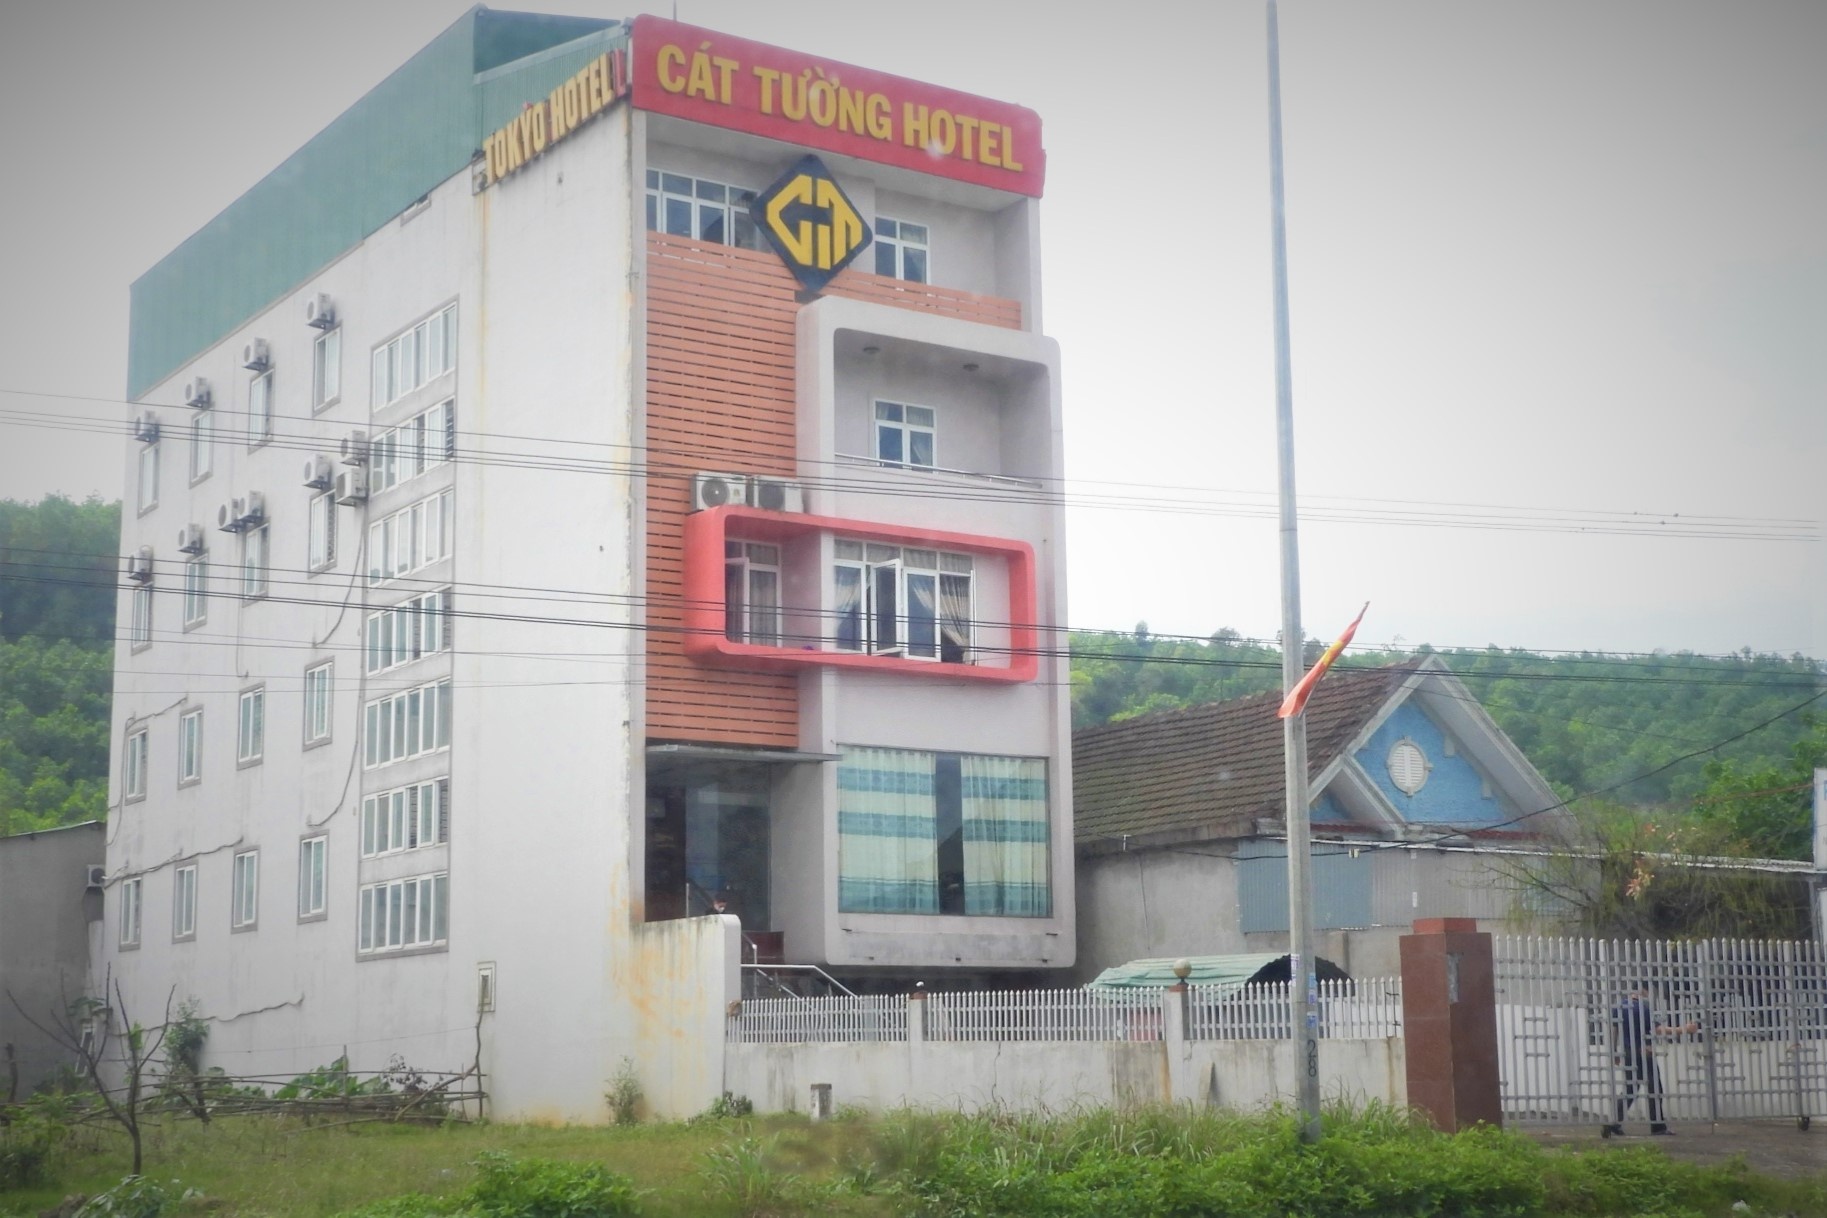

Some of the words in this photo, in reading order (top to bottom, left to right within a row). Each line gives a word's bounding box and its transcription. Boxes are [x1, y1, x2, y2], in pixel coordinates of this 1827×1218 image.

[483, 102, 547, 183] TOKYO
[550, 53, 615, 142] HOTEL
[657, 41, 739, 105] CÁT
[753, 66, 892, 141] TƯỜNG
[903, 102, 1024, 172] HOTEL
